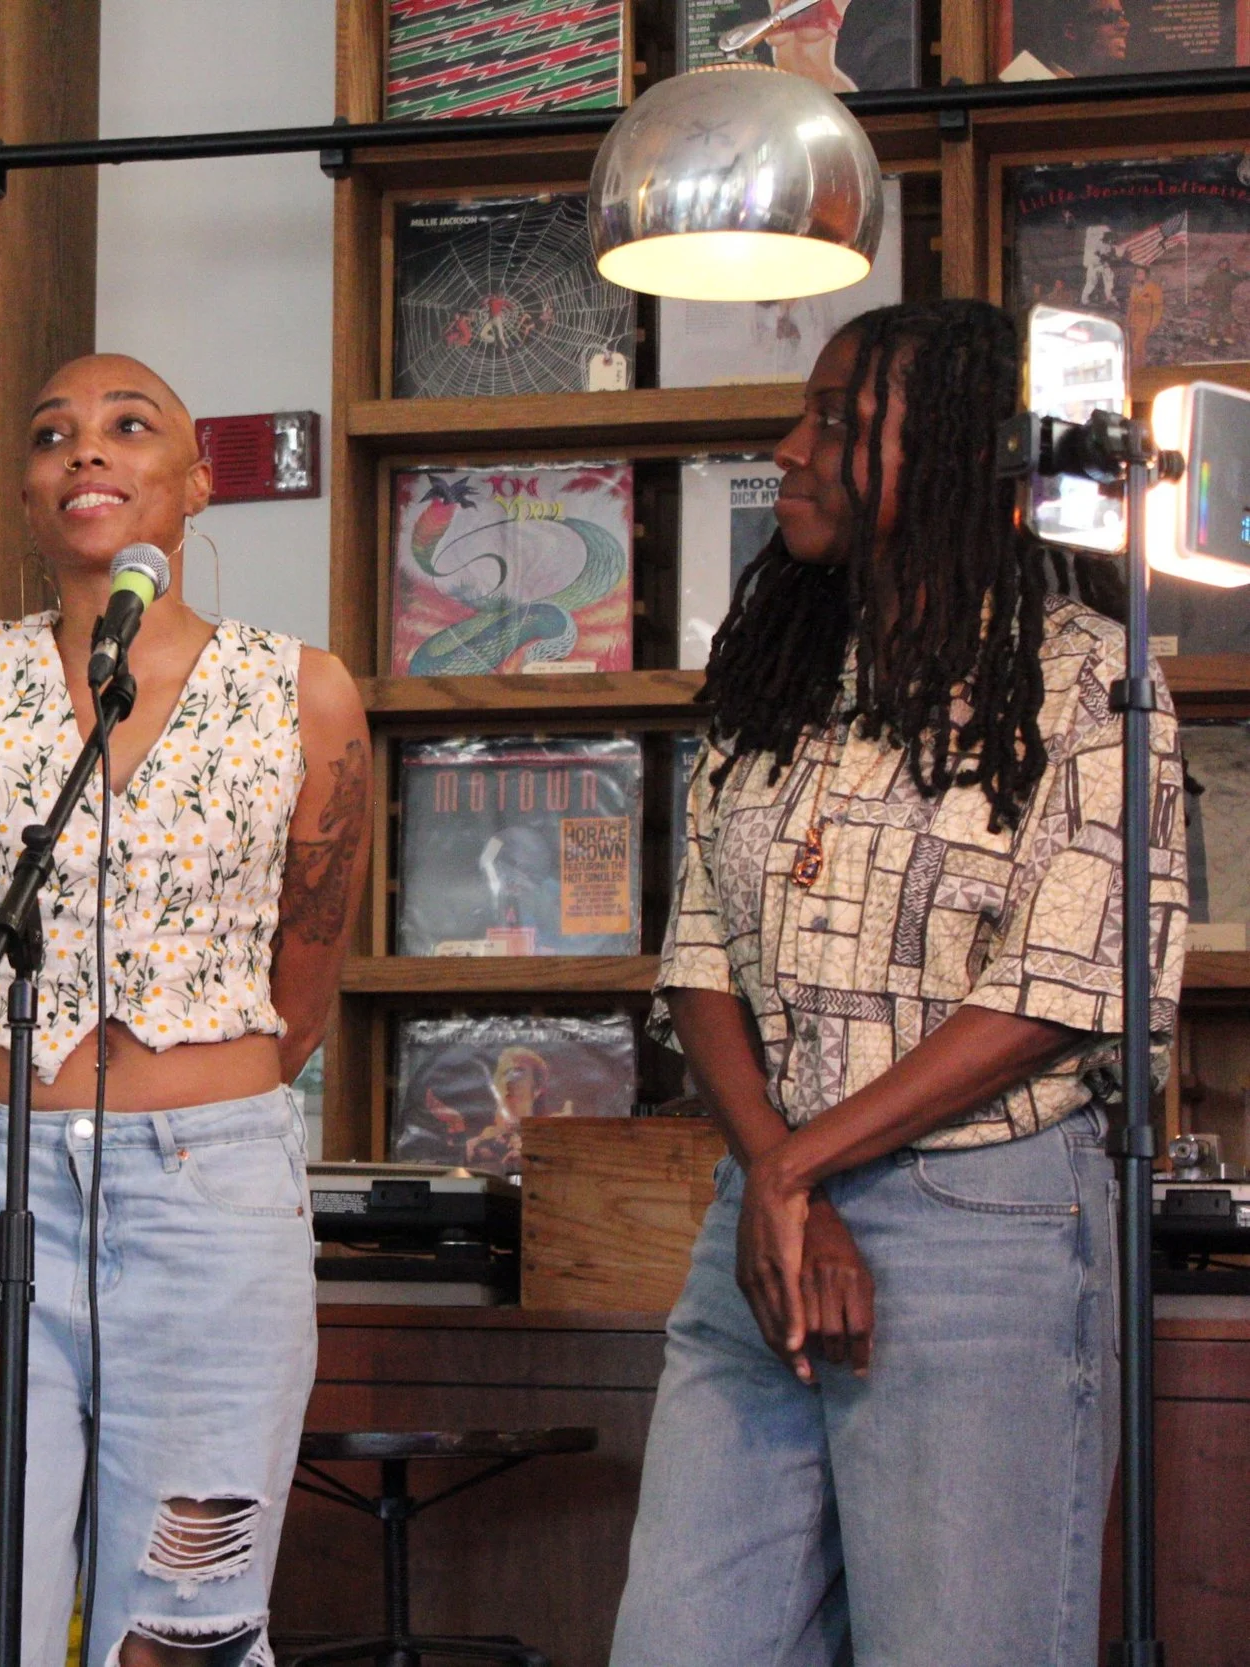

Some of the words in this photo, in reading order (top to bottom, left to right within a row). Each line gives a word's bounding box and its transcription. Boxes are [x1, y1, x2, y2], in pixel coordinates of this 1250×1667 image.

[410, 218, 438, 227] MILLIE
[439, 215, 478, 226] JACKSON
[730, 477, 782, 490] MOO
[730, 490, 757, 505] DICK
[761, 490, 778, 504] HY
[434, 769, 597, 813] MOTOWN
[564, 824, 628, 845] HORACE
[564, 842, 627, 861] BROWN
